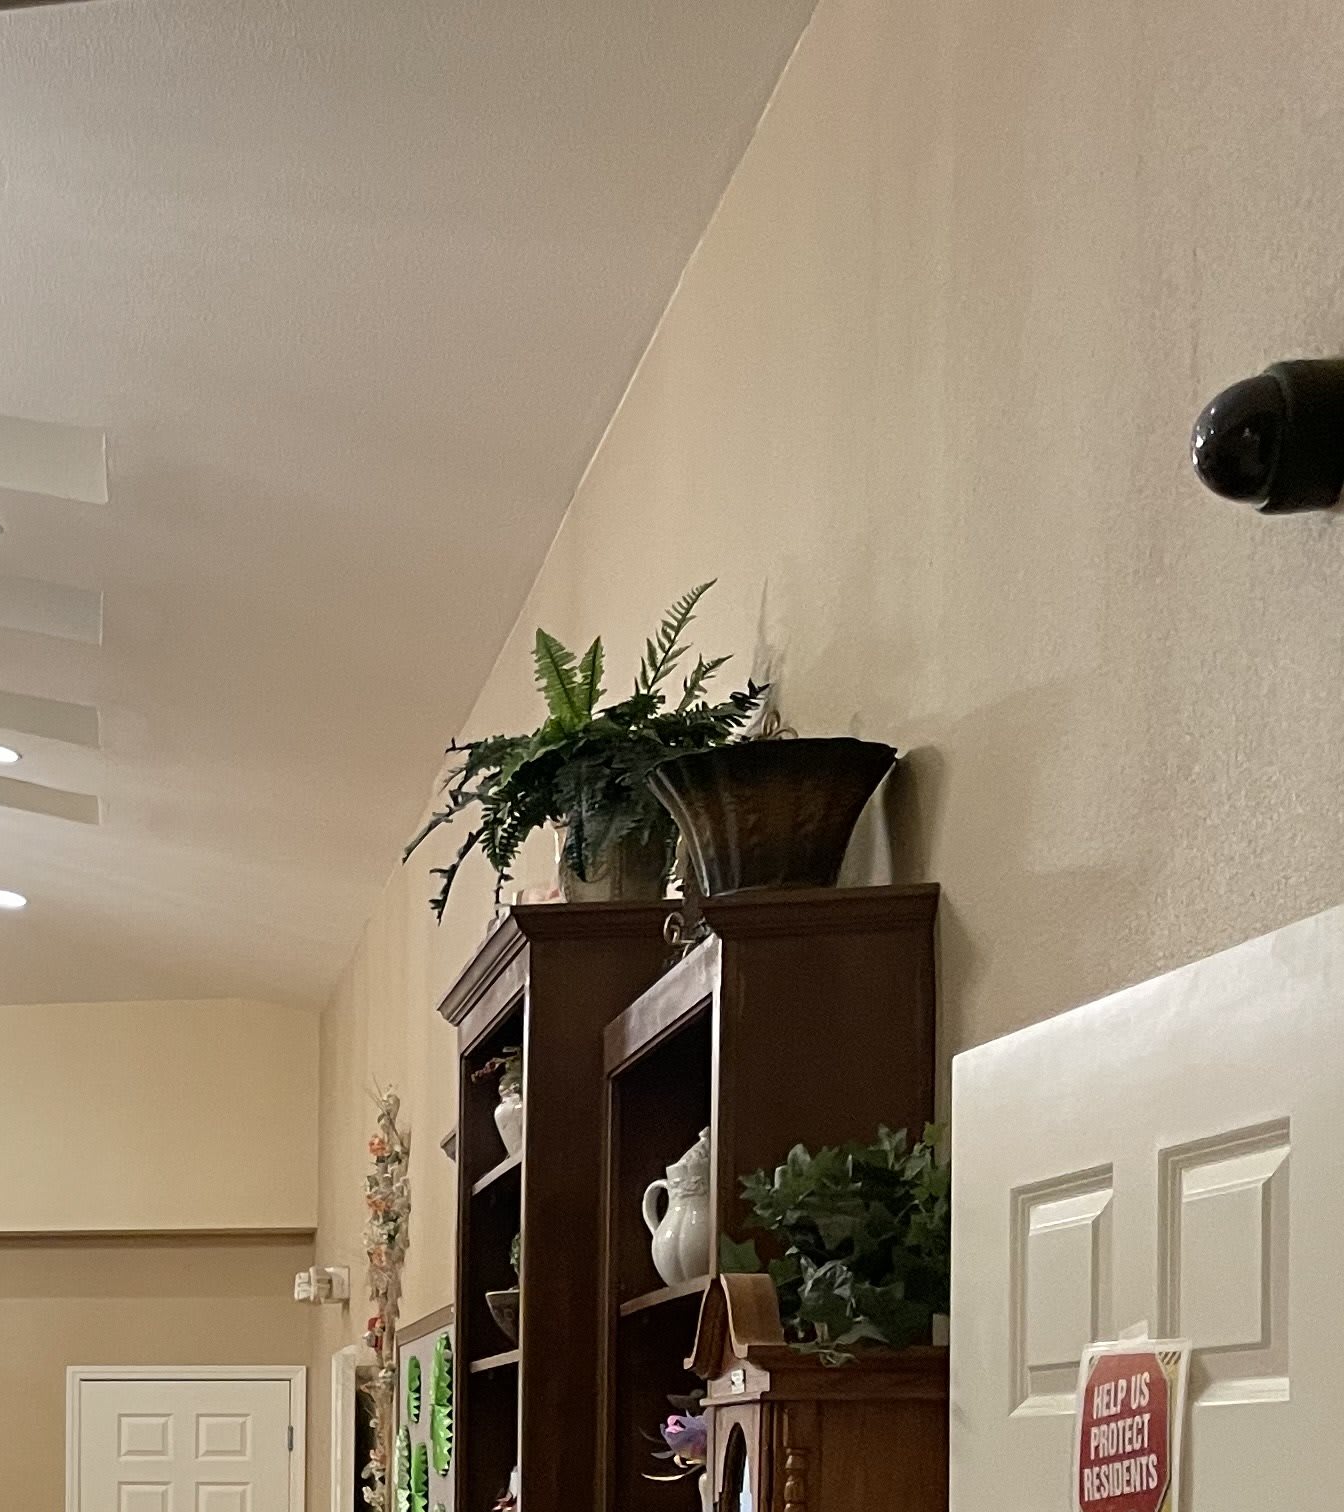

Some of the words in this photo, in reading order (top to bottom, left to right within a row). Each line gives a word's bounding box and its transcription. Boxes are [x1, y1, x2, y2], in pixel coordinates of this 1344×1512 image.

[1093, 1379, 1127, 1419] HELP
[1130, 1372, 1151, 1410] US
[1090, 1413, 1151, 1460] PROTECT
[1084, 1453, 1158, 1502] RESIDENTS
